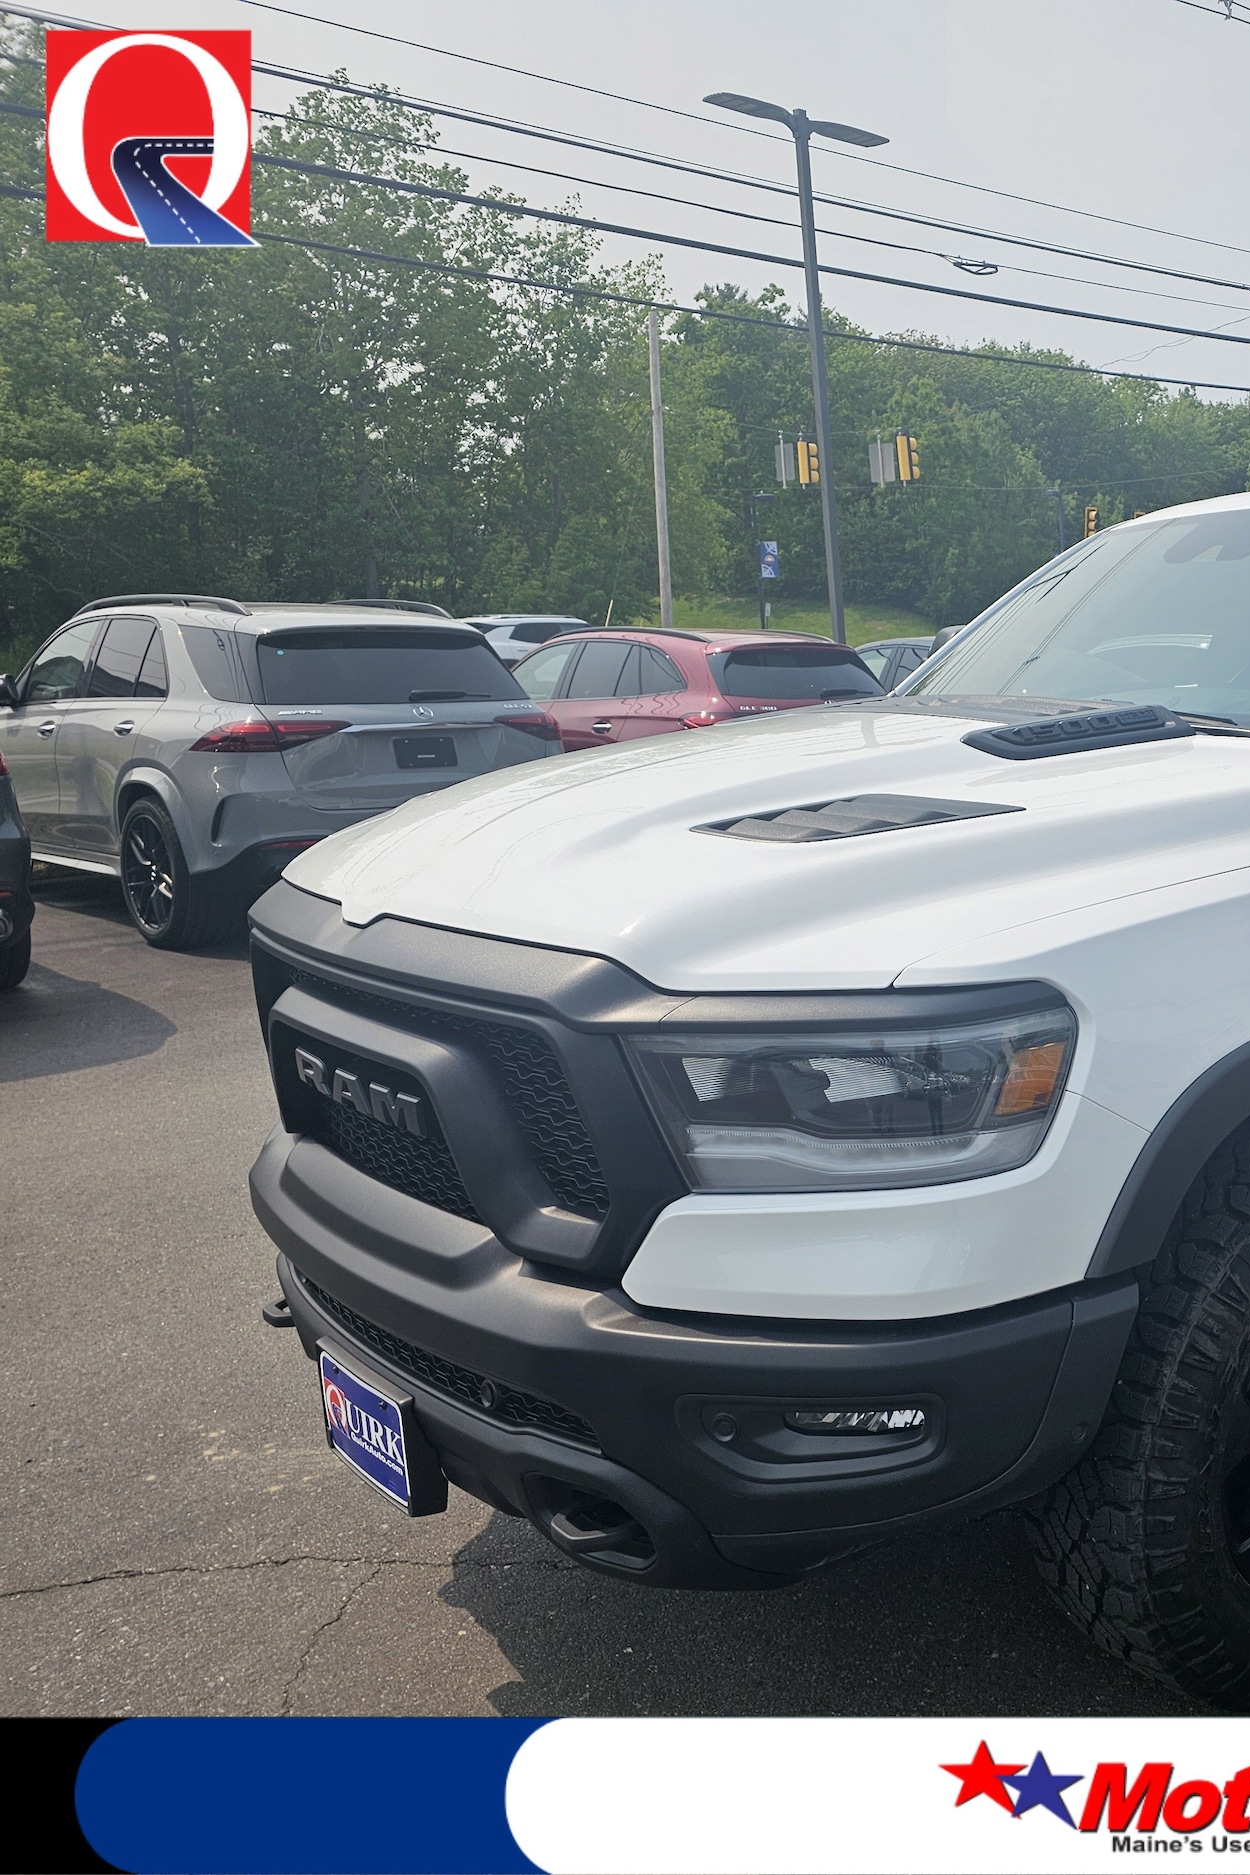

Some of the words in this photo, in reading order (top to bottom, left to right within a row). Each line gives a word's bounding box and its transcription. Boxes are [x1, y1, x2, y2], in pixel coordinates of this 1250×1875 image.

[1012, 715, 1118, 742] 1500
[294, 1046, 427, 1139] RAM
[325, 1381, 405, 1467] QUIRK
[350, 1431, 404, 1476] QuirkAuto.com
